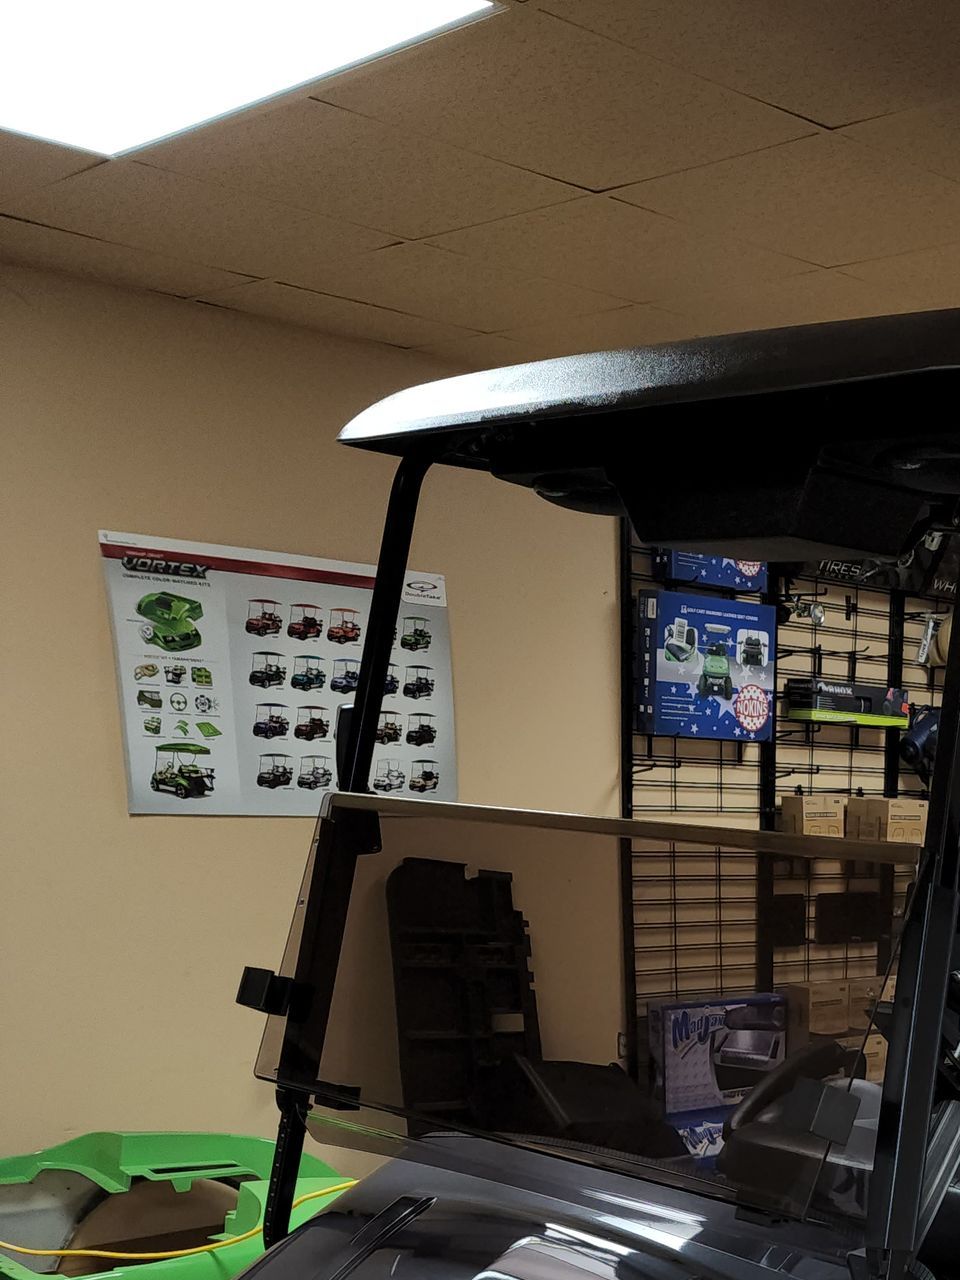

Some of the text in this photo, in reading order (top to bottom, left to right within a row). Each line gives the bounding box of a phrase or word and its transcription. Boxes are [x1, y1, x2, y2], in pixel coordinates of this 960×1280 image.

[122, 556, 206, 577] VORTEX
[819, 559, 861, 576] TIRES
[736, 699, 768, 717] NOKINS
